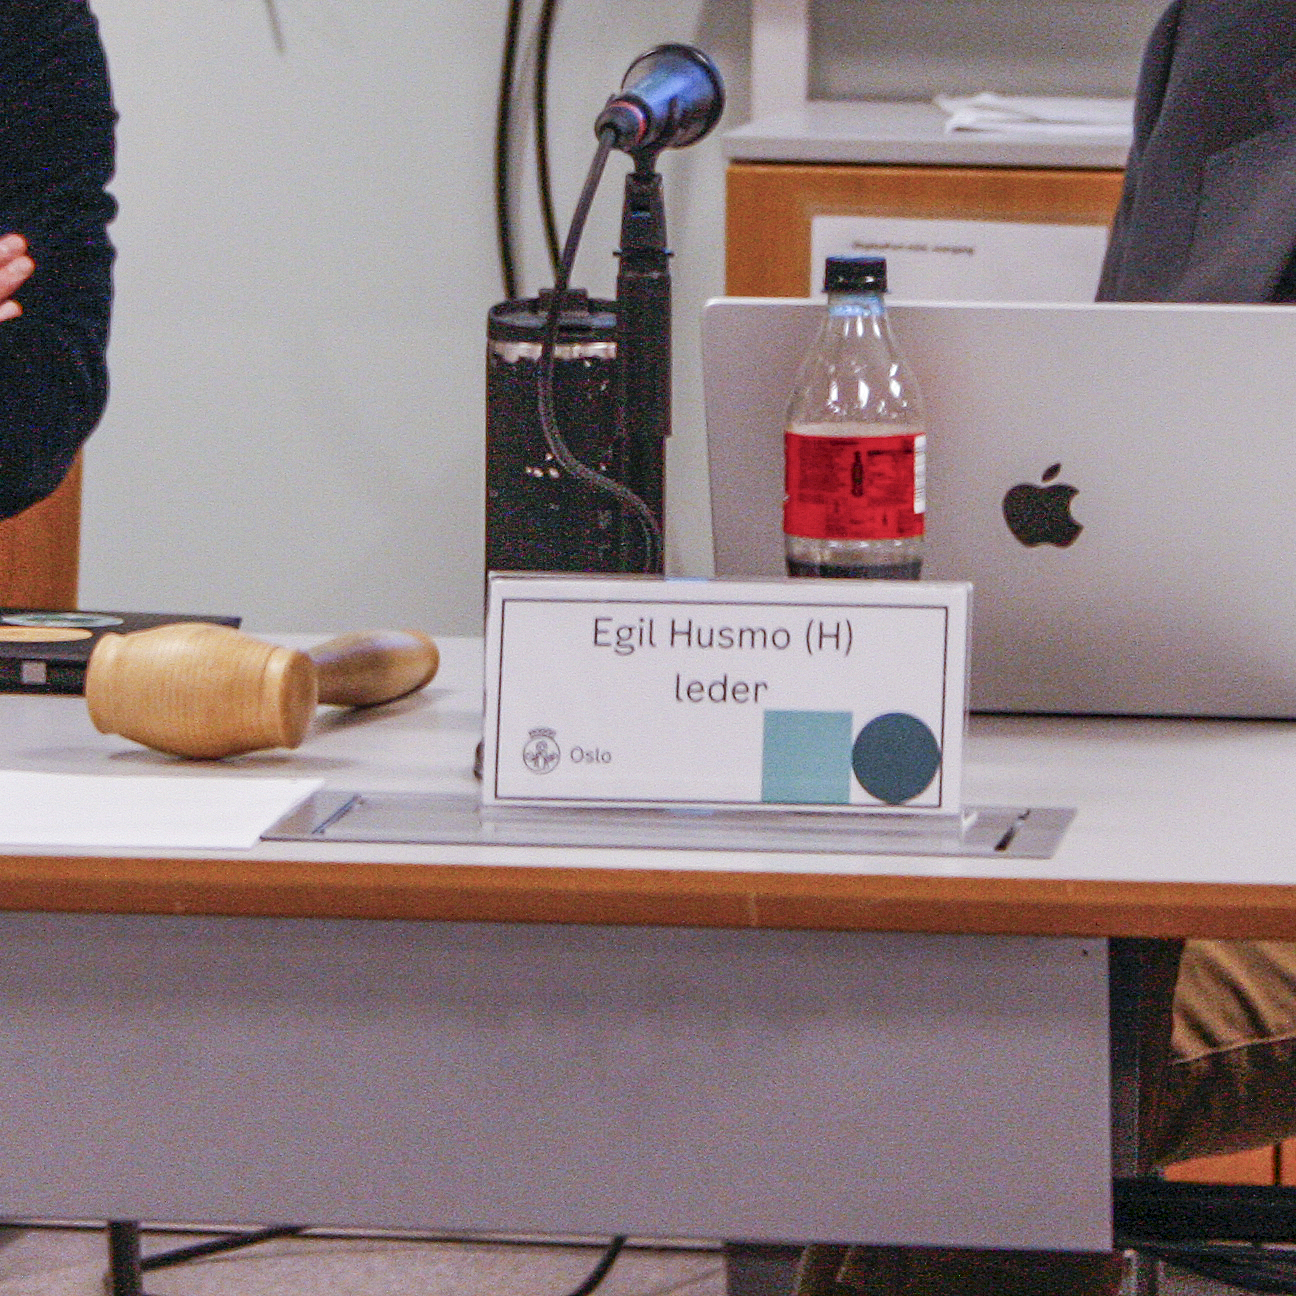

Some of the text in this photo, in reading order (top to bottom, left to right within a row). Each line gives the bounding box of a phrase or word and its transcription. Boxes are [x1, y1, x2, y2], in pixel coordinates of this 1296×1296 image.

[593, 617, 854, 656] Egil Husmo (H)
[675, 673, 768, 704] leder
[570, 746, 612, 764] Oslo
